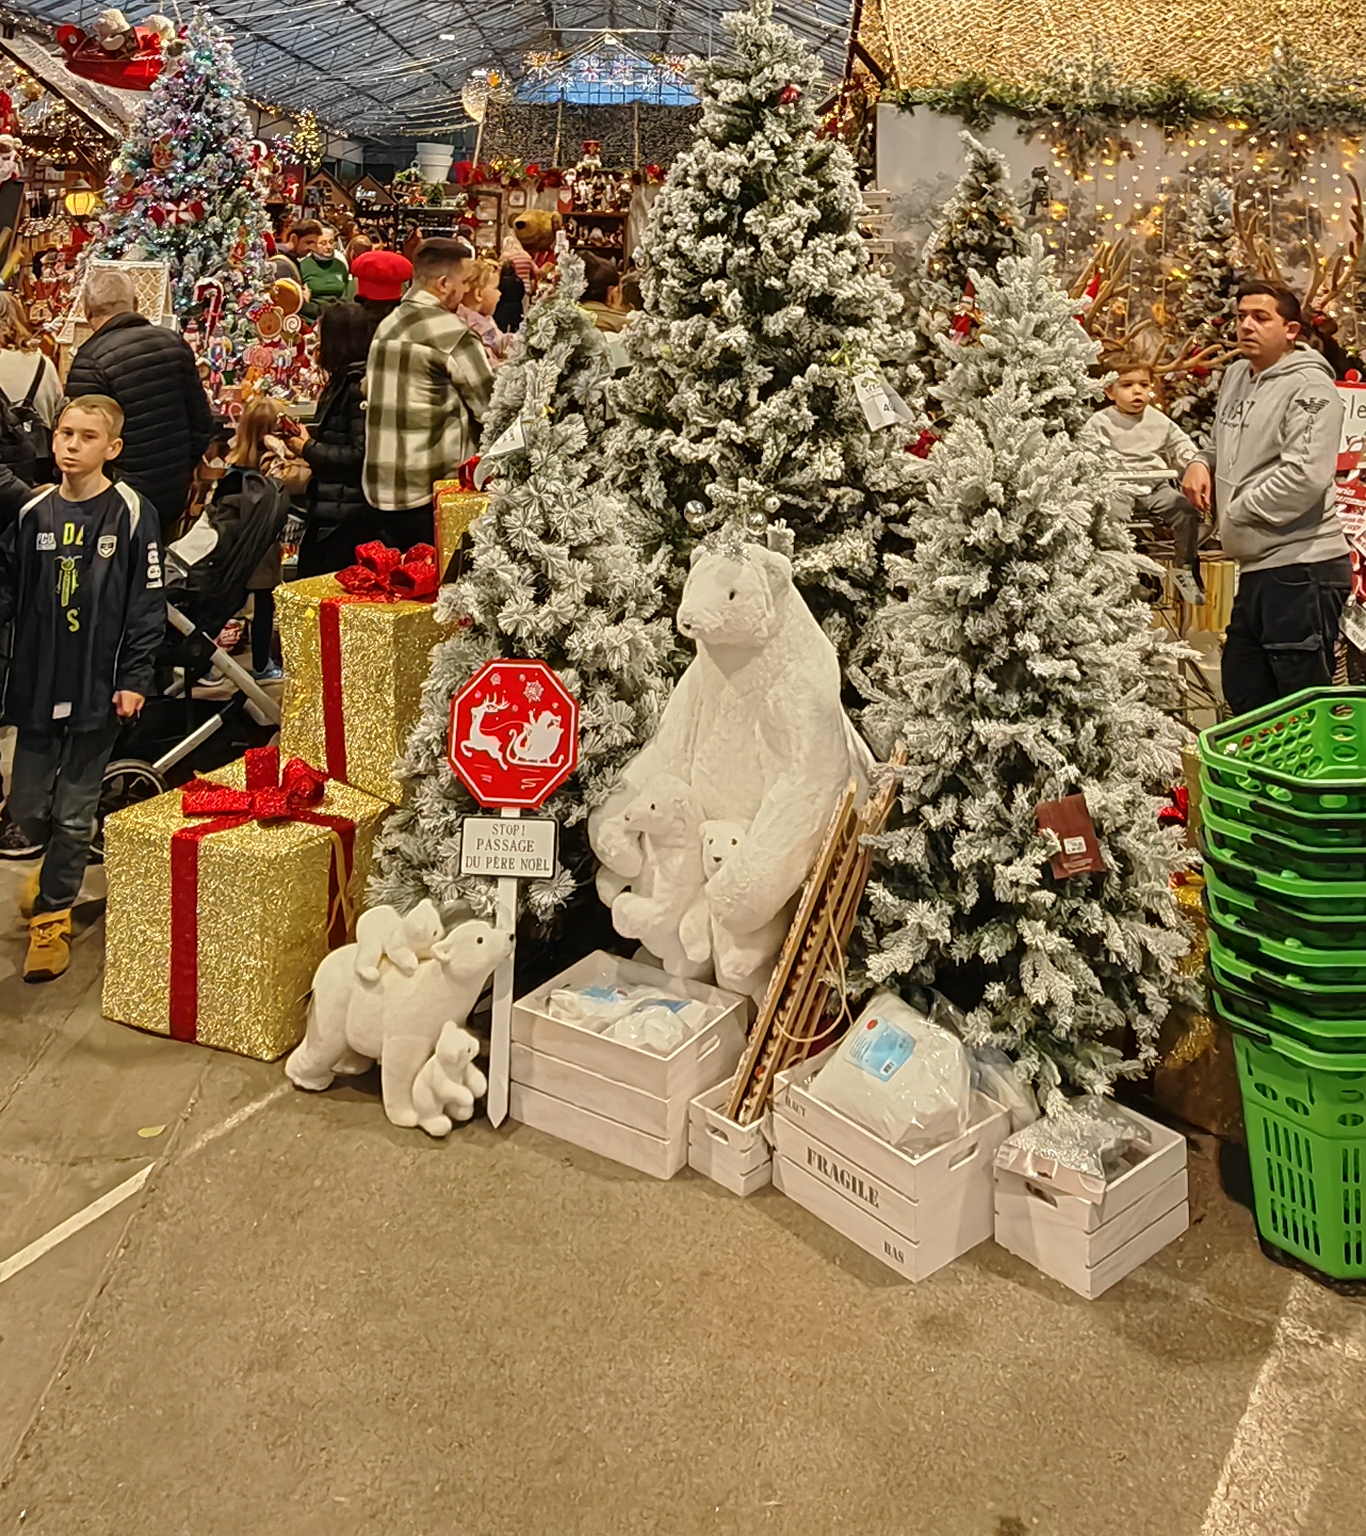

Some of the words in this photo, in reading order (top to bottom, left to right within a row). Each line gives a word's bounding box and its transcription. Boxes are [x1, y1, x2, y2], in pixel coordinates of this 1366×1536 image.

[476, 837, 535, 853] PASSAGE
[465, 855, 481, 869] DU
[485, 855, 516, 870] PÈRE
[520, 857, 550, 872] NOËL
[806, 1145, 880, 1209] FRAGILE
